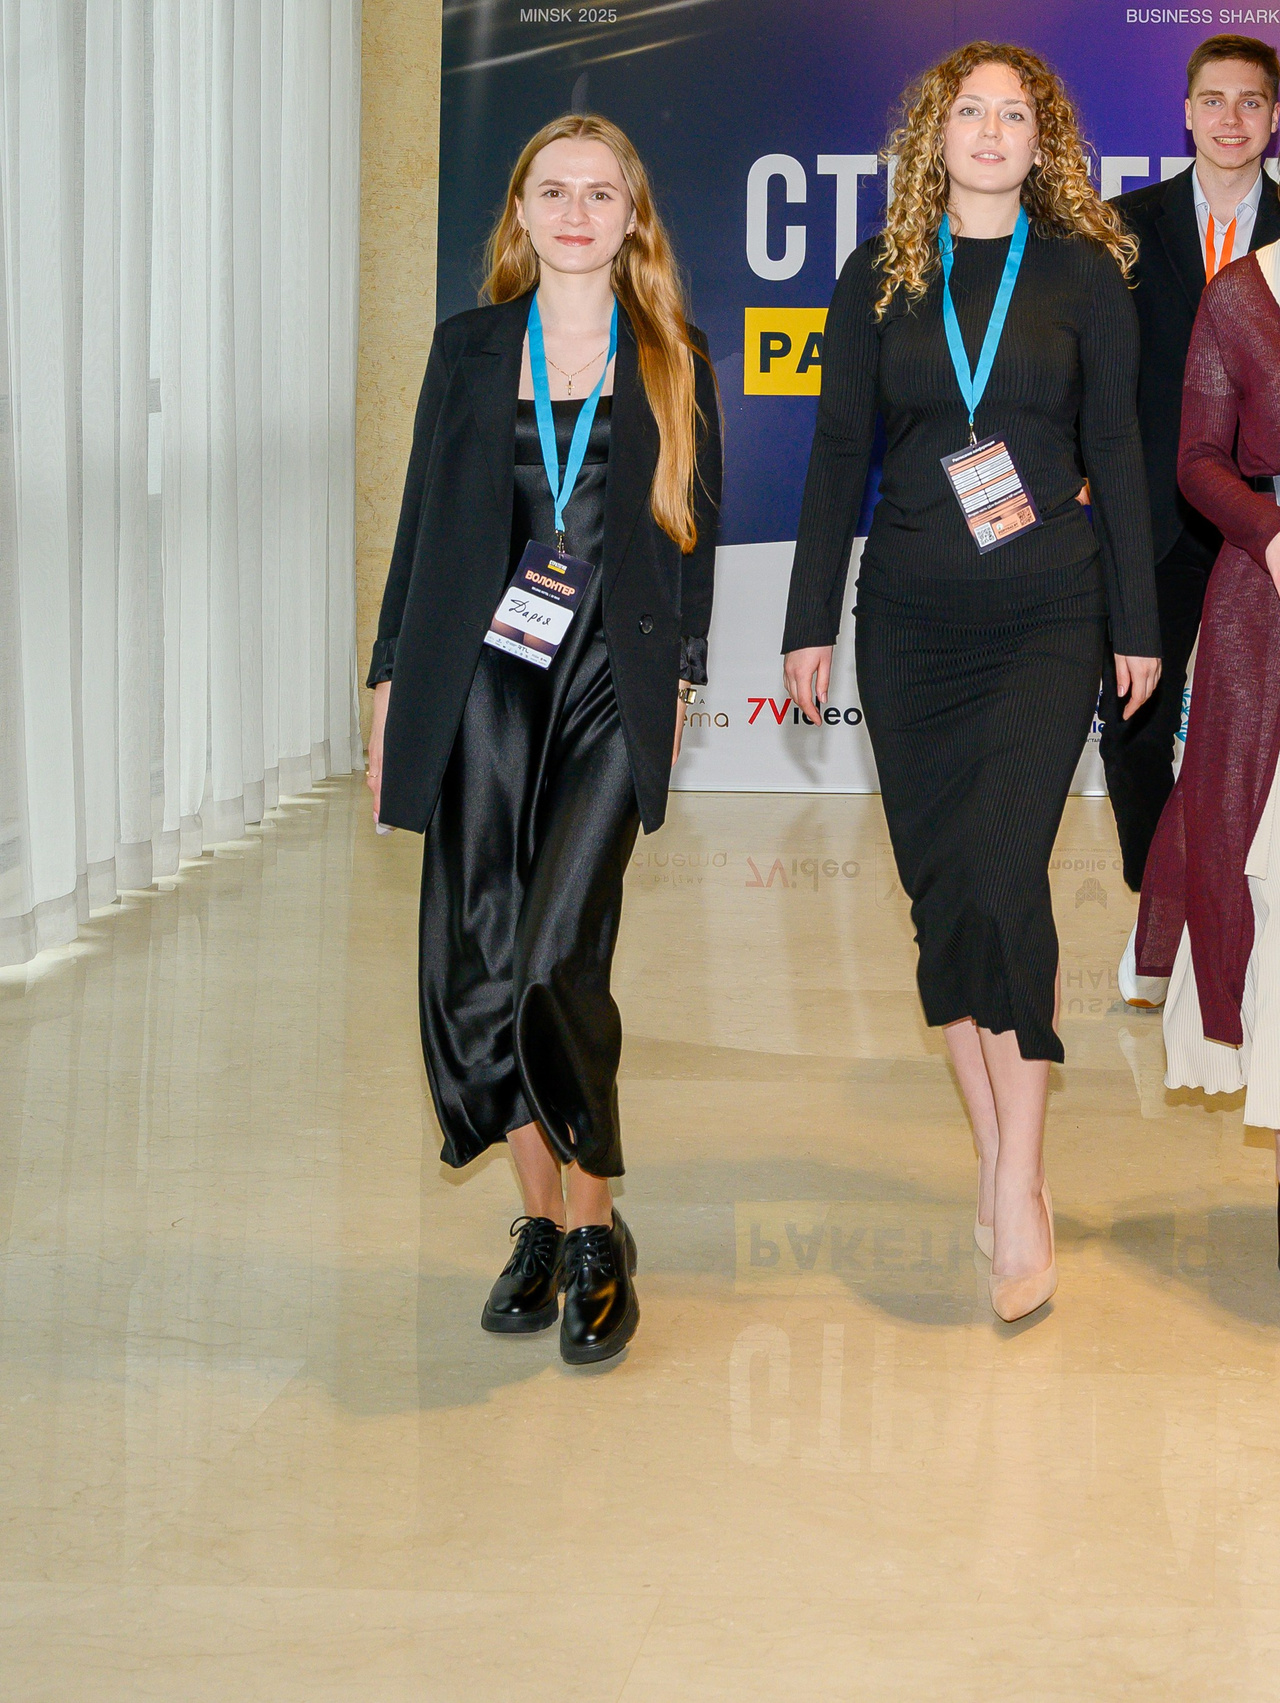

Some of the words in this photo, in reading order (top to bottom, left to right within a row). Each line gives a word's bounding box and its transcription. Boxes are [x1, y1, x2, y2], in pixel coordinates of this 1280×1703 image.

[520, 8, 572, 23] MINSK
[578, 8, 618, 23] 2025
[1126, 9, 1213, 24] BUSINESS
[525, 570, 576, 597] ВОЛОНТЕР
[508, 599, 552, 626] Дарья
